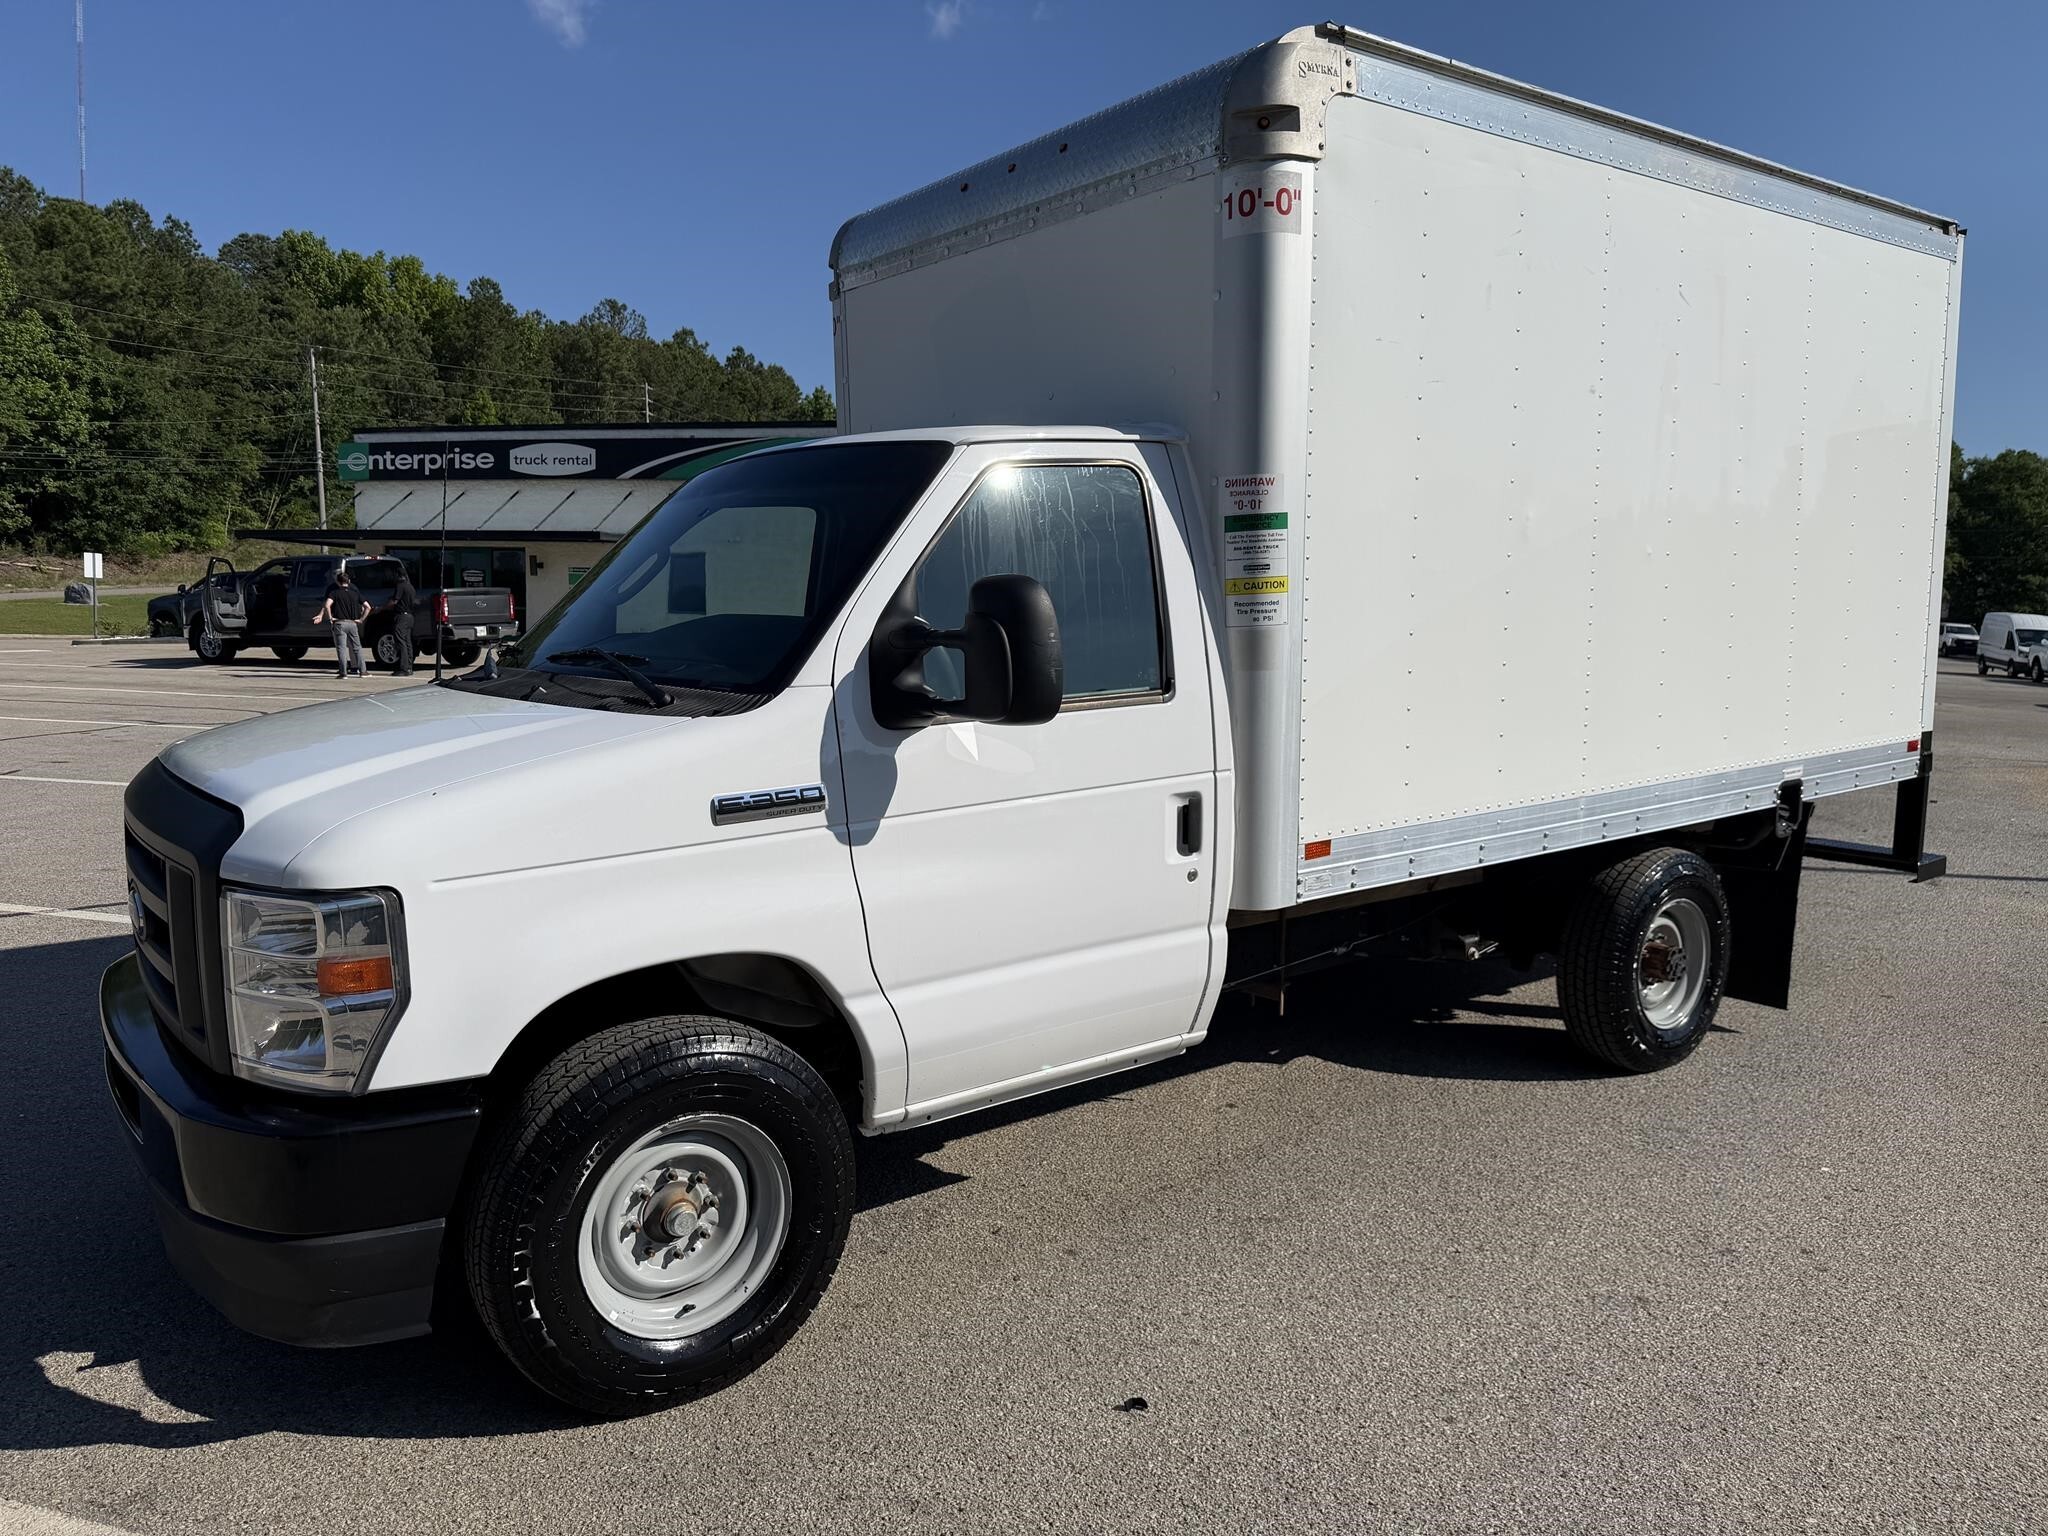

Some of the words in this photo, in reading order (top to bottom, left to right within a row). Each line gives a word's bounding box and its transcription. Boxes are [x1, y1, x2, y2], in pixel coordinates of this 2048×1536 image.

[1298, 61, 1339, 78] SMYRNA
[1223, 187, 1302, 220] 10'-0"
[345, 447, 495, 475] enterprise
[513, 452, 548, 466] truck
[553, 452, 592, 466] rental
[1243, 580, 1285, 591] CAUTION
[1234, 599, 1279, 608] Recommended
[766, 808, 797, 817] SUPER
[798, 805, 823, 814] DUTY
